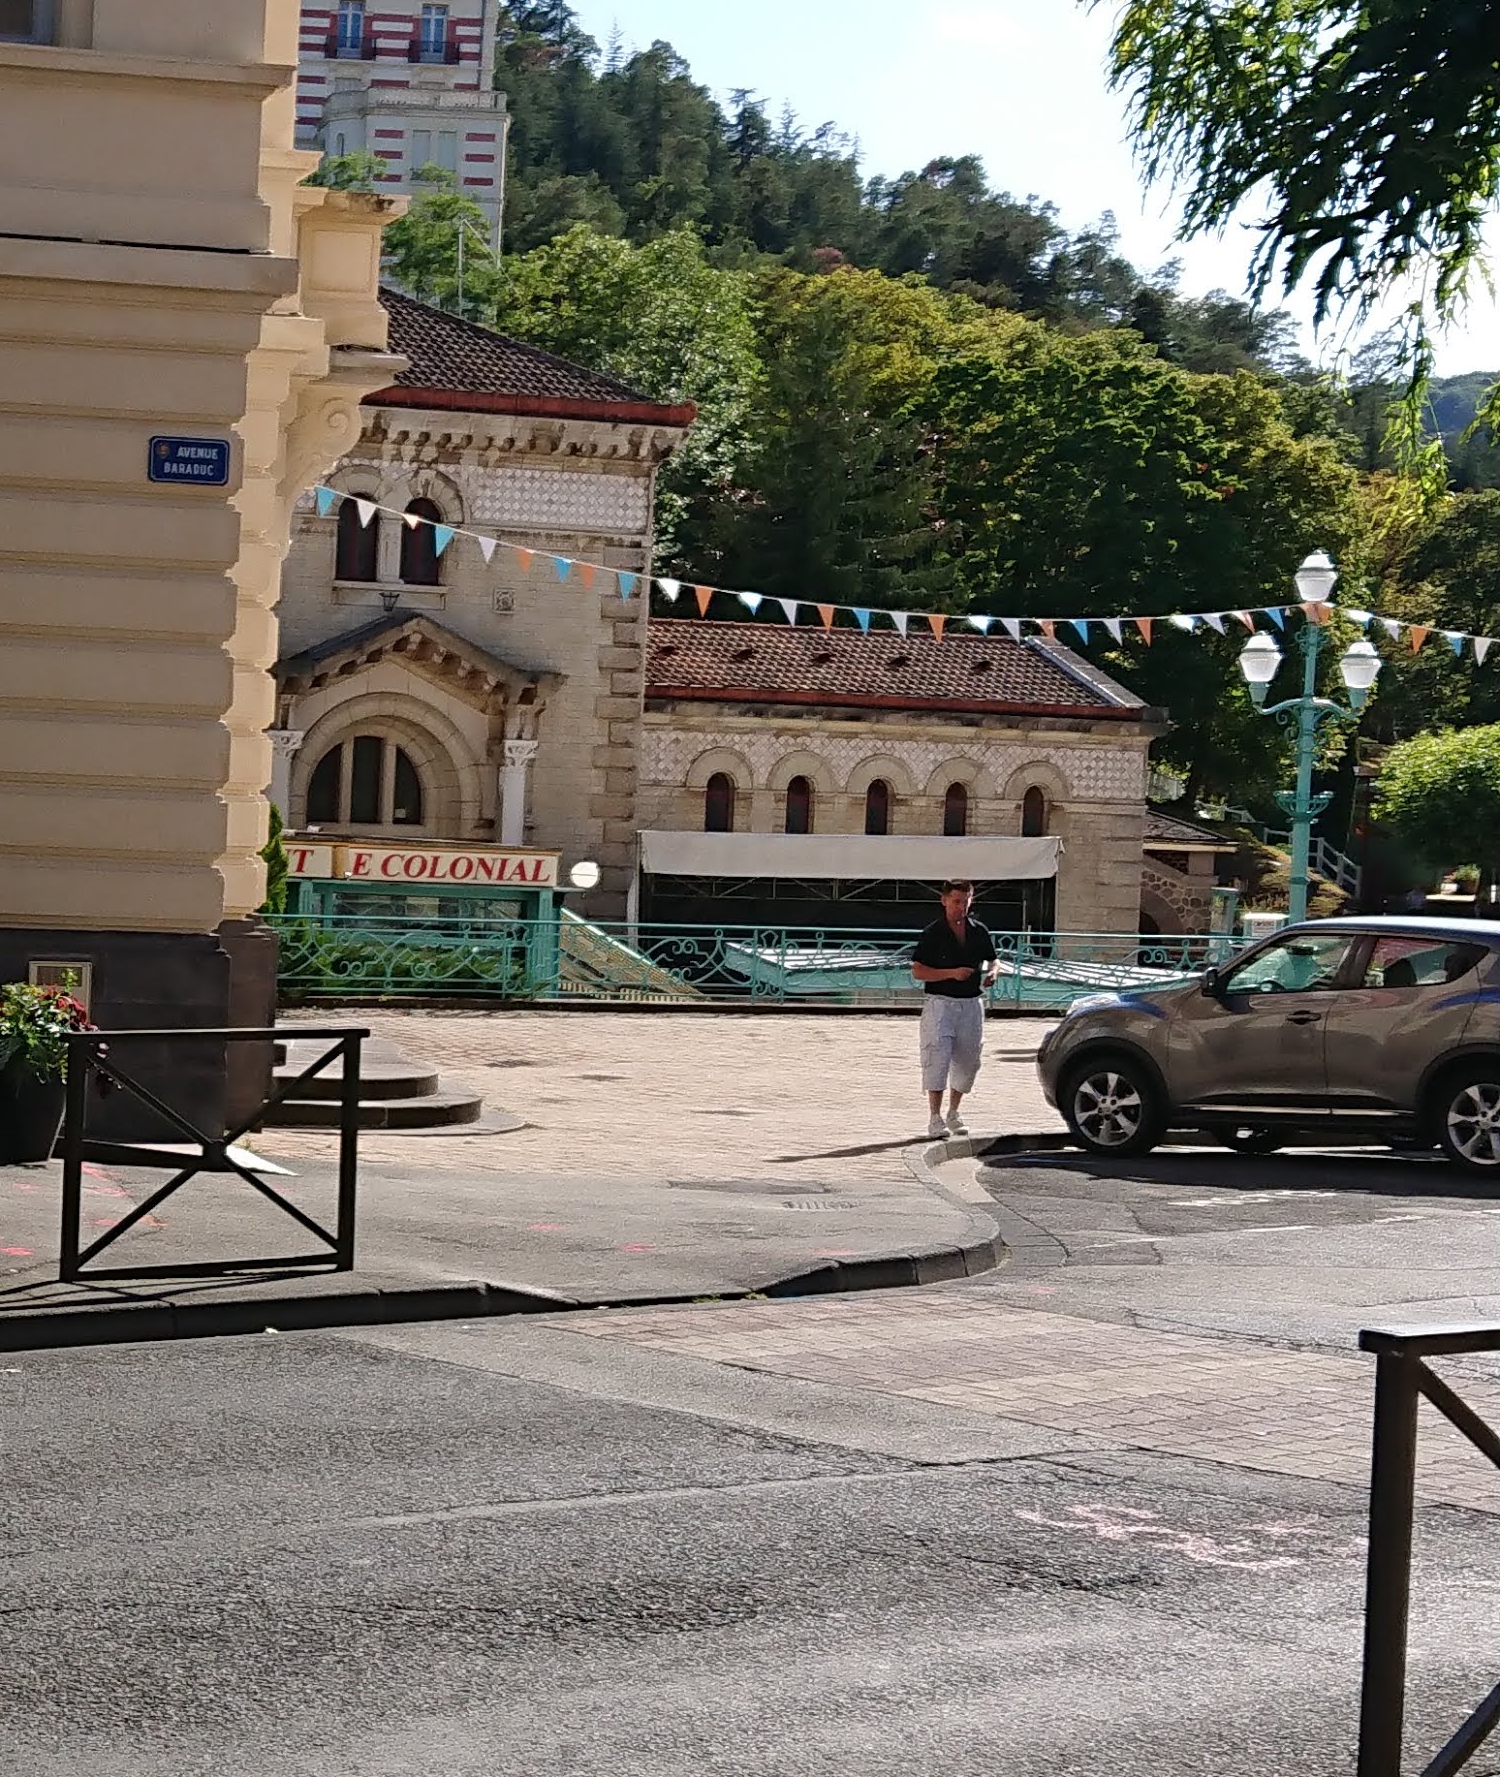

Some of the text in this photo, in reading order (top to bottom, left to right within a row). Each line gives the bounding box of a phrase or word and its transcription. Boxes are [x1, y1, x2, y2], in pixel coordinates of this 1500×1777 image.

[177, 446, 218, 459] AVENUE
[164, 462, 214, 476] BARADUC
[380, 853, 551, 883] COLONIAL
